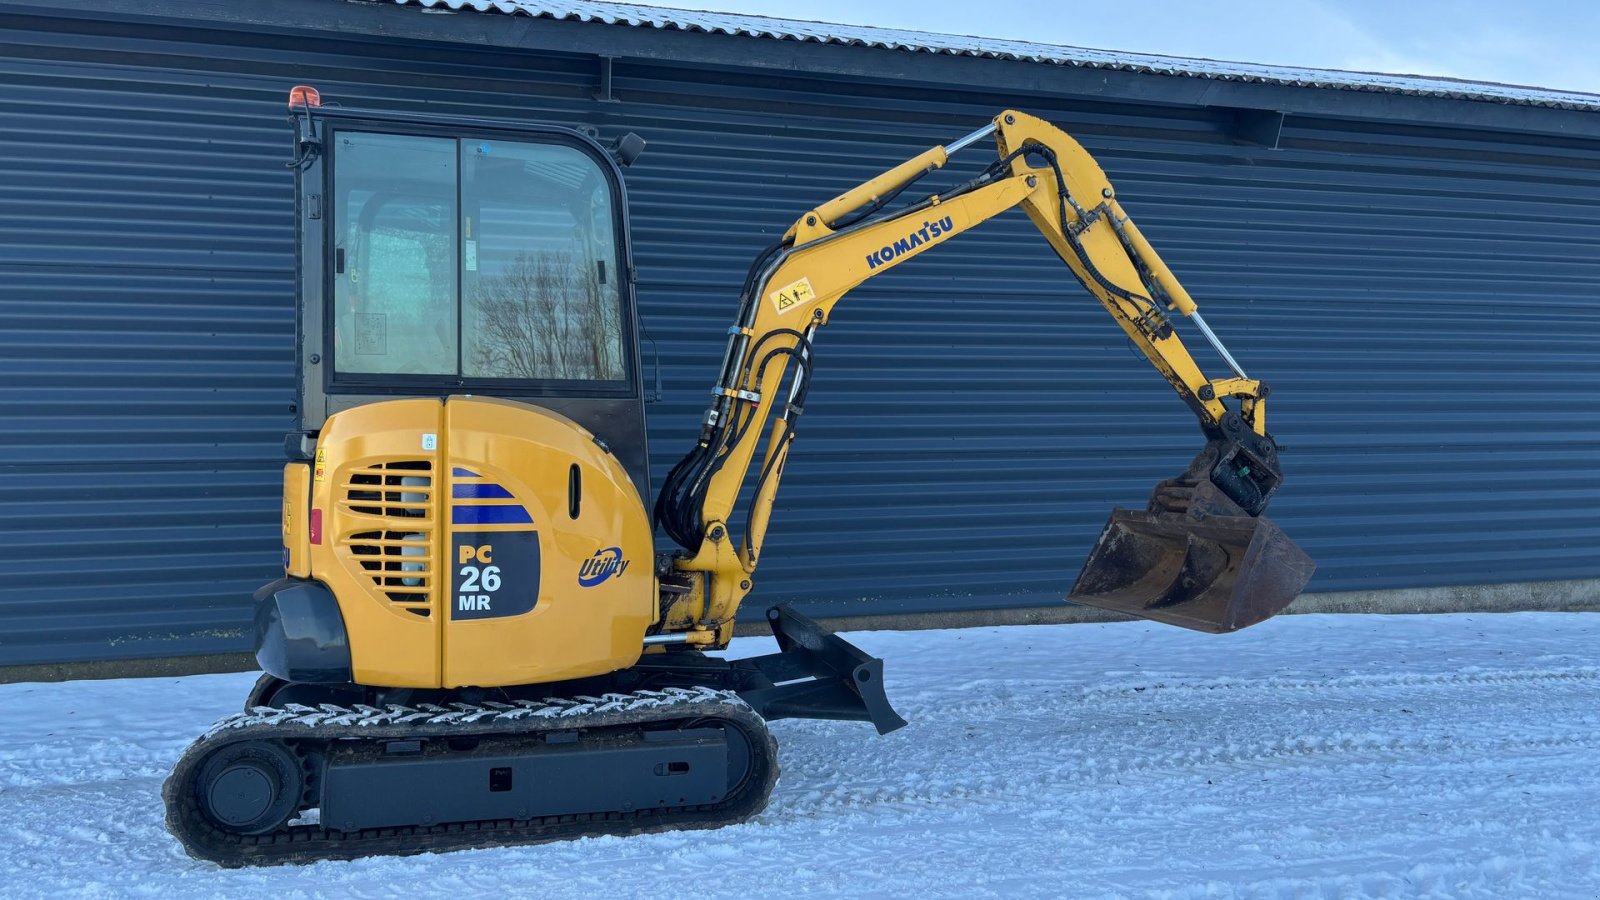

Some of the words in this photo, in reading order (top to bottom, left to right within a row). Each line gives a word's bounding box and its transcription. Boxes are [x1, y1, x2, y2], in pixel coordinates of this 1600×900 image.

[866, 216, 953, 269] KOMATSU
[459, 545, 492, 564] PC
[579, 554, 630, 578] Utility
[459, 566, 502, 592] 26
[458, 595, 491, 611] MR
